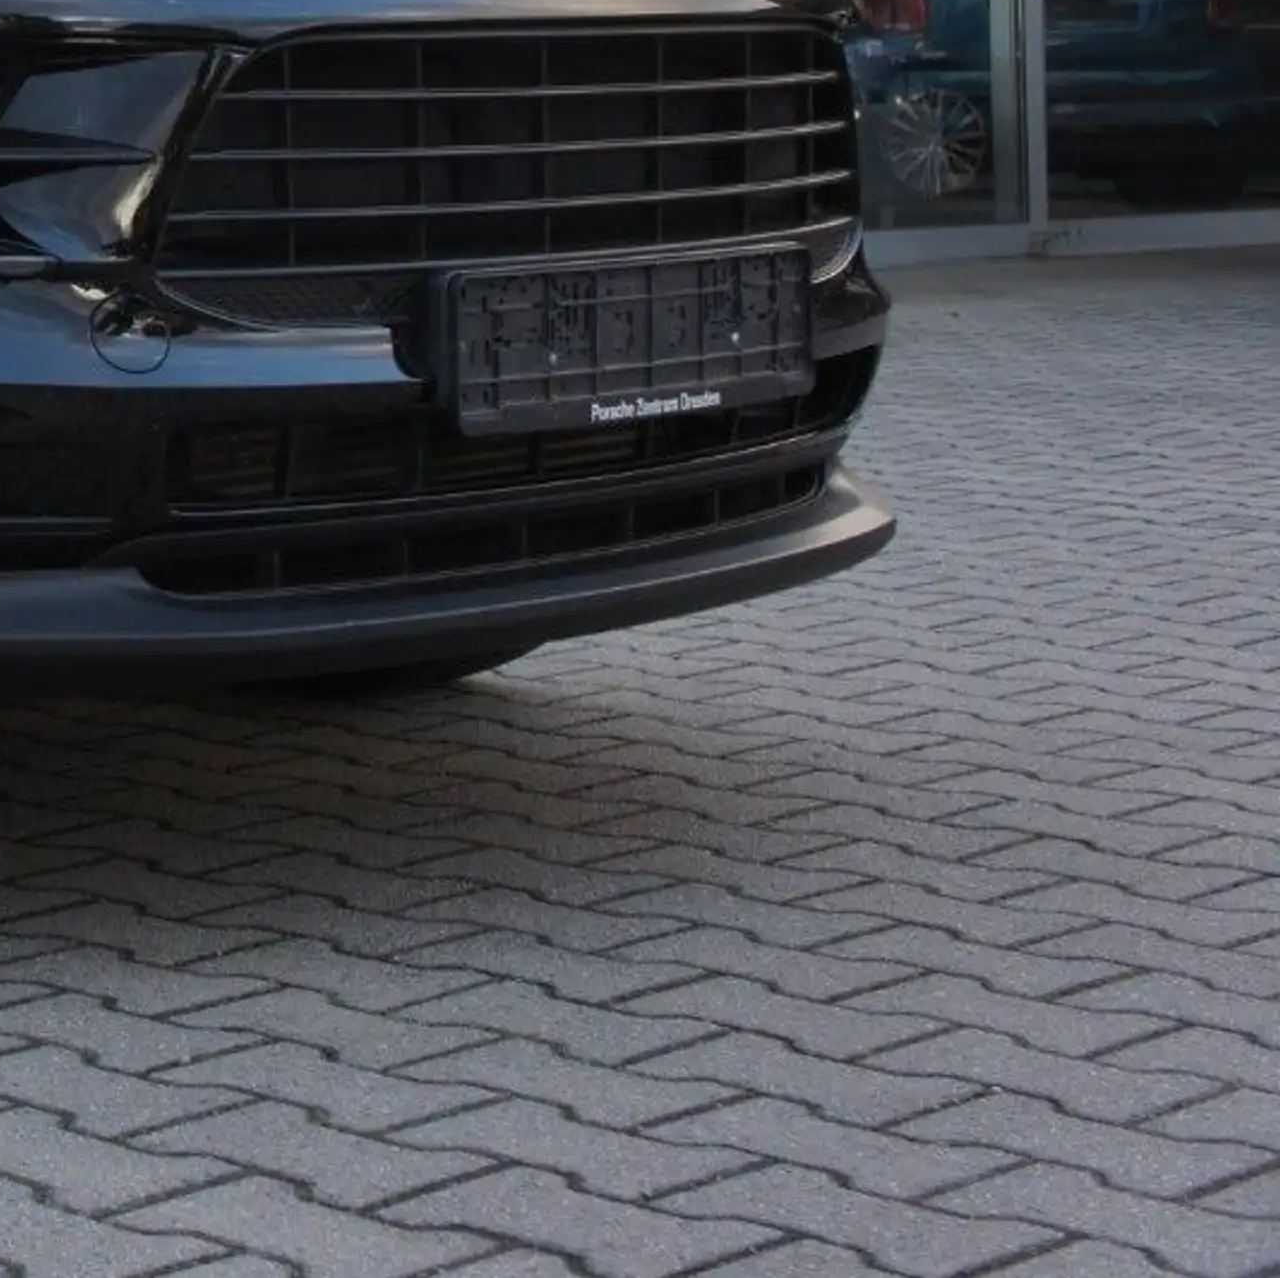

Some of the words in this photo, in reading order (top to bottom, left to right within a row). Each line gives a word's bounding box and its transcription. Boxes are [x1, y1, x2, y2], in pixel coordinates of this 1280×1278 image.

[590, 400, 635, 423] Porsche
[636, 396, 678, 416] Zentrum
[680, 390, 721, 410] Dresden
